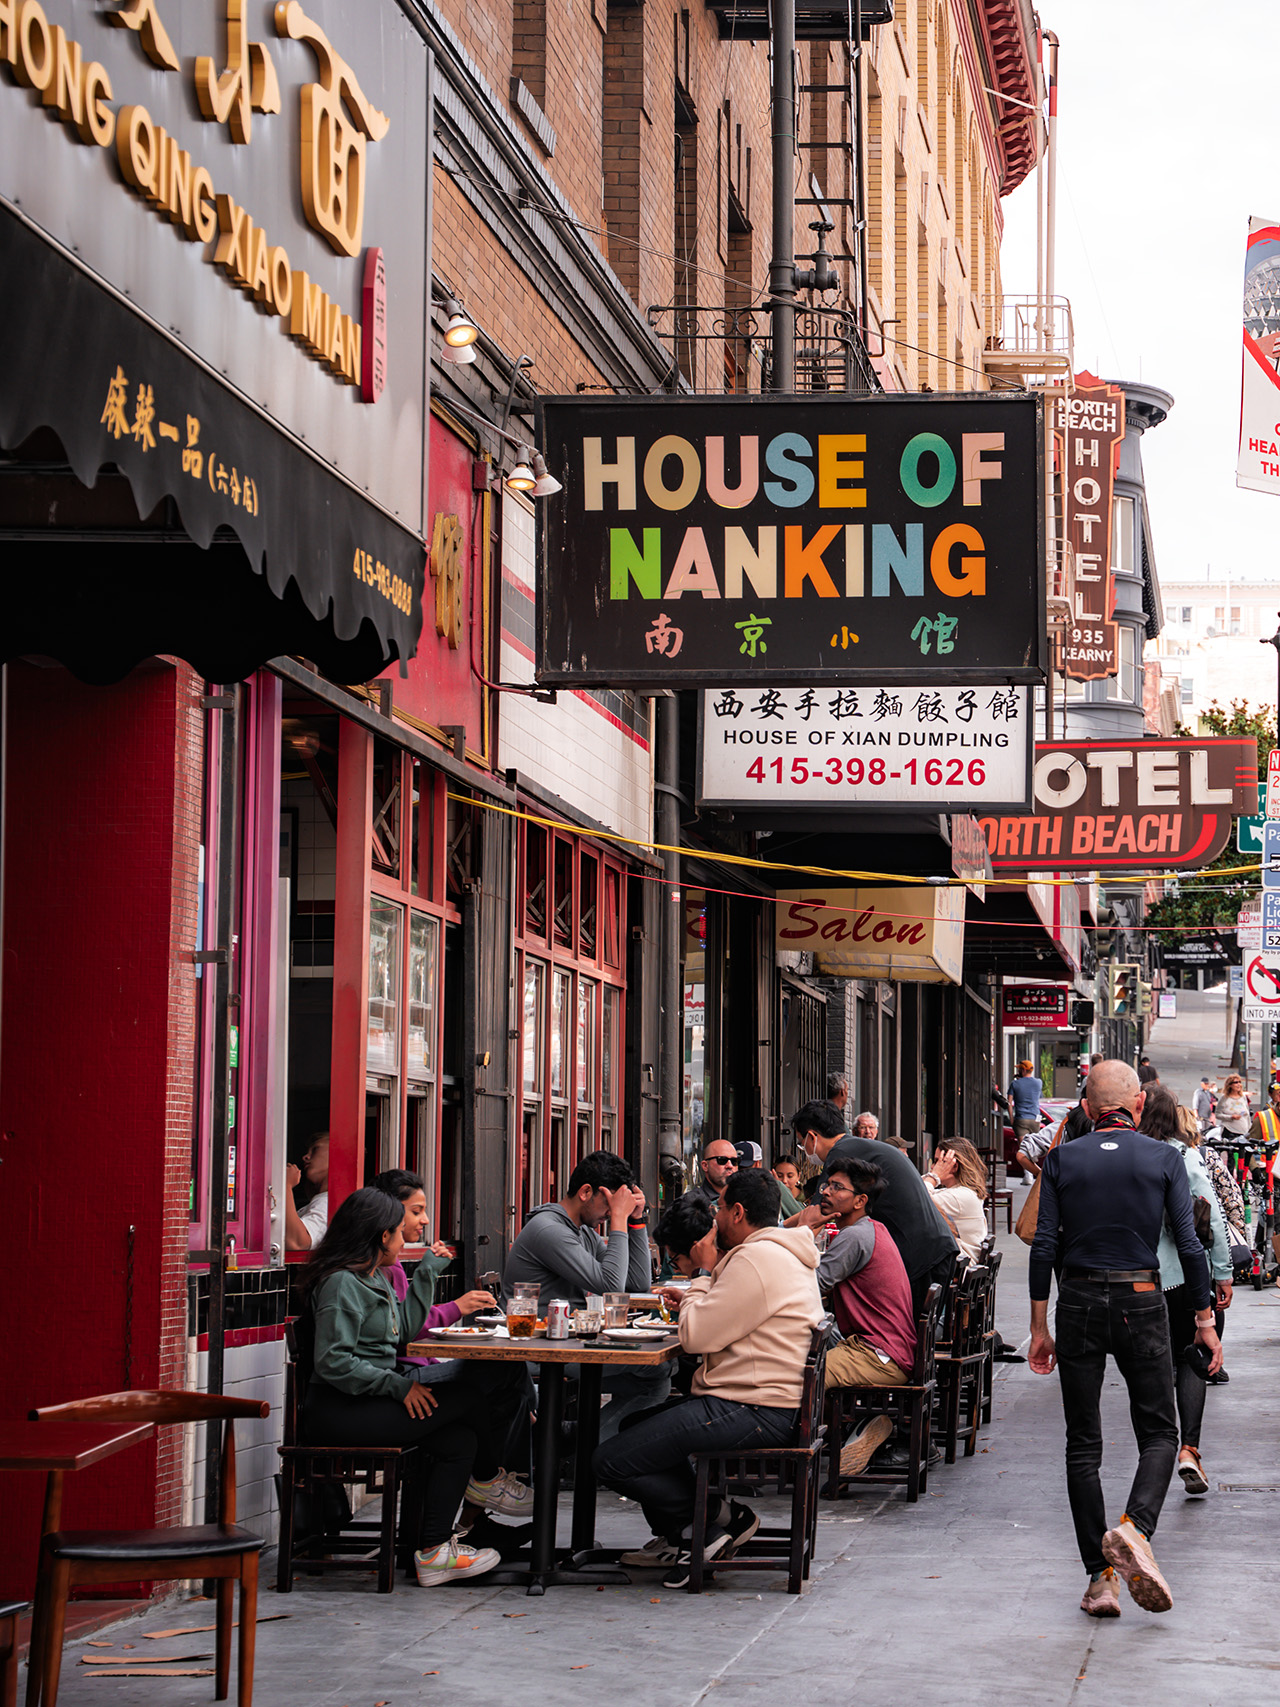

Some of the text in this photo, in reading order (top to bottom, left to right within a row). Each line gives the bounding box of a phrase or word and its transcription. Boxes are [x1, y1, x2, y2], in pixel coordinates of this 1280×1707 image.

[117, 104, 217, 243] QING
[214, 194, 292, 317] XIAO
[291, 270, 361, 386] MIAN
[1057, 398, 1117, 417] NORTH
[1057, 415, 1117, 433] BEACH
[583, 432, 1005, 511] HOUSE OF
[1073, 437, 1102, 621] HOTEL
[610, 523, 987, 600] NANKING
[1072, 629, 1104, 645] 935
[1062, 646, 1113, 663] KEARNY
[723, 730, 1010, 747] HOUSE OF XIAN DUMPLING
[746, 756, 987, 786] 415-398-1626
[1034, 750, 1233, 809] OTEL
[1272, 775, 1280, 788] 2
[979, 813, 1183, 856] ORTH BEACH
[779, 898, 926, 946] Salon
[1240, 912, 1249, 922] NO
[1013, 995, 1058, 1006] TOPPU
[1246, 1009, 1264, 1019] INTO
